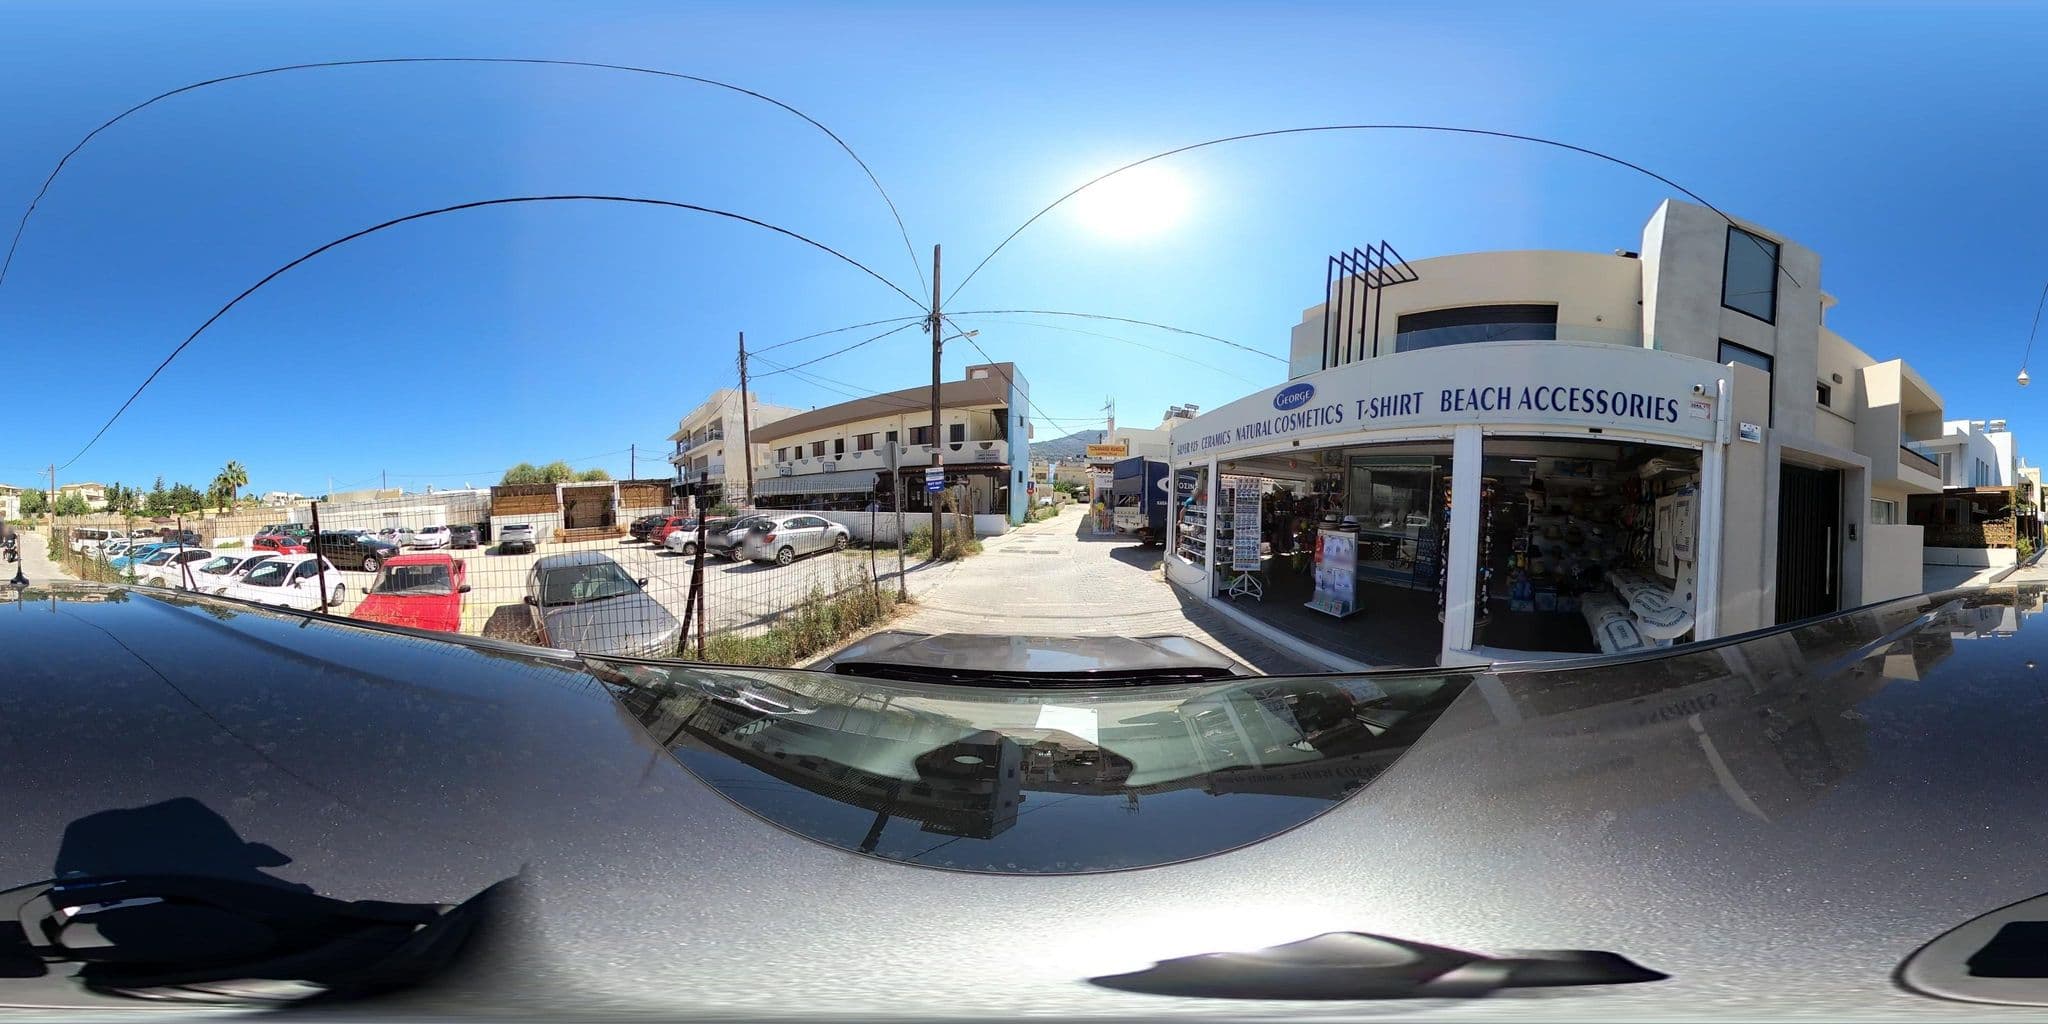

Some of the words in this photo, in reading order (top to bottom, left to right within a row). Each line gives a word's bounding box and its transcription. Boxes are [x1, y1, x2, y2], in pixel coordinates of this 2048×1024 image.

[1201, 430, 1231, 450] CERAMICS
[1236, 420, 1273, 440] NATURAL
[1274, 403, 1343, 433] COSMETICS
[1356, 391, 1424, 420] T-SHIRT
[1440, 386, 1512, 412] BEACH
[1518, 385, 1679, 423] ACCESSORIES
[1276, 390, 1311, 407] GEORGE
